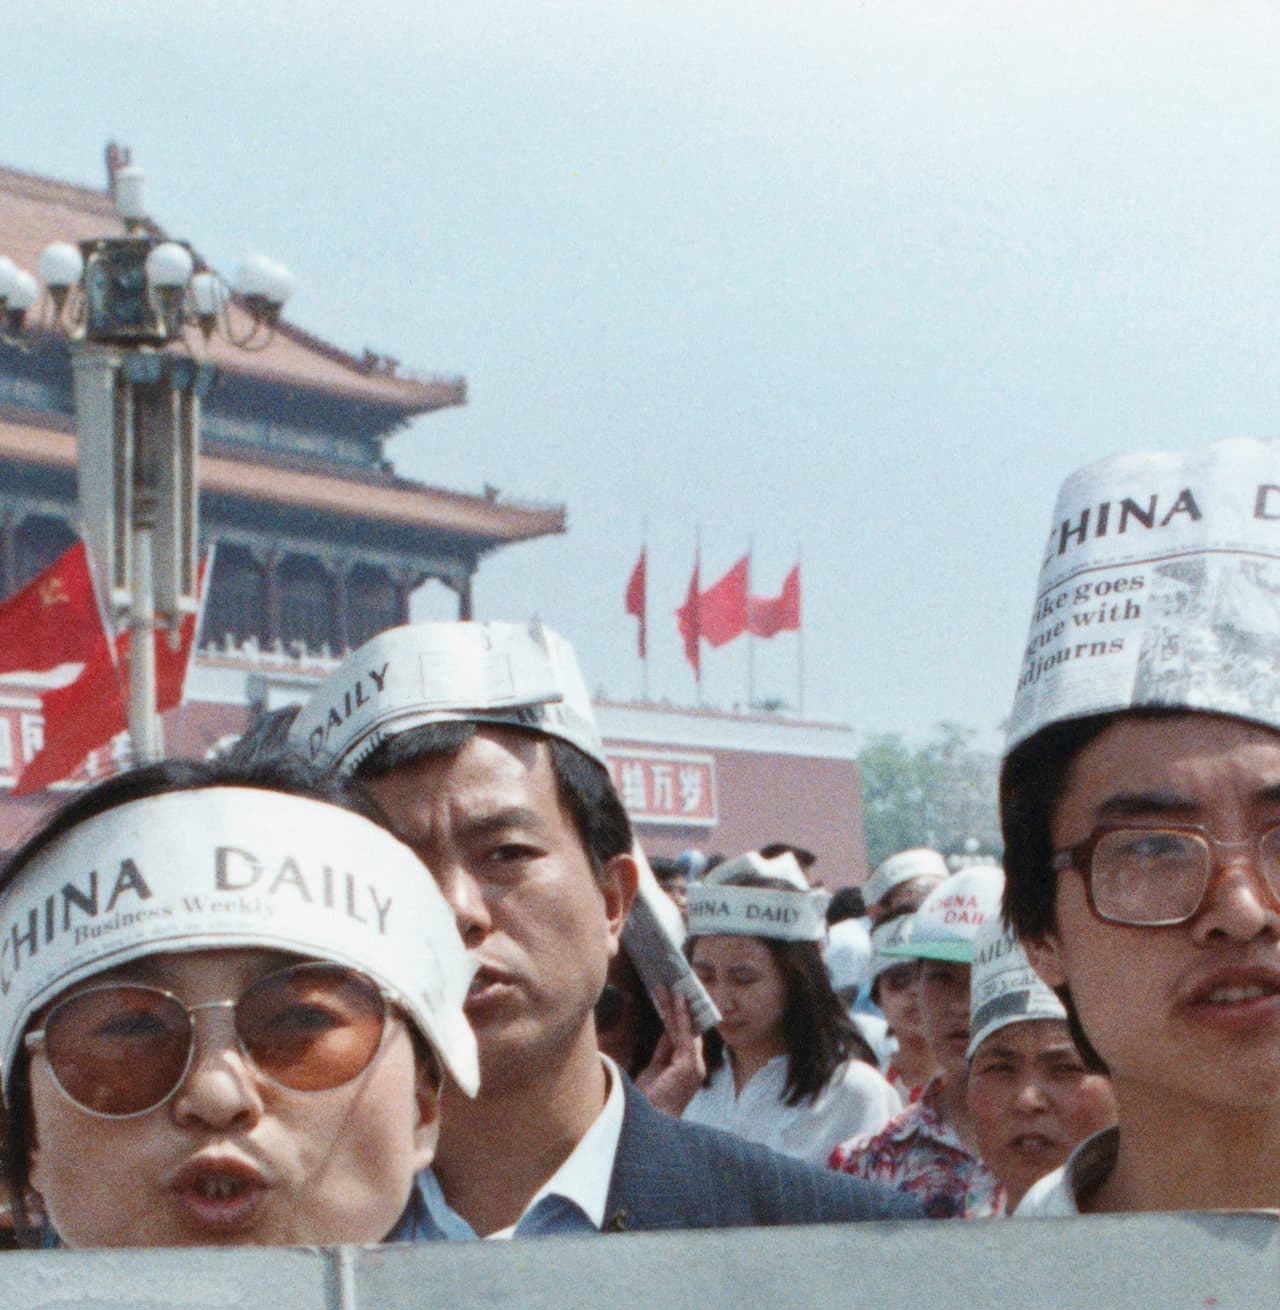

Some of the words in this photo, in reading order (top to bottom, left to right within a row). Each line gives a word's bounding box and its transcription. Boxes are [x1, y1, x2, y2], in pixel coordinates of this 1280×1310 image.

[1042, 488, 1202, 568] HINA
[1072, 598, 1141, 628] with
[1073, 575, 1145, 606] goes
[309, 662, 389, 757] DAILY
[0, 856, 153, 996] CHINA
[214, 845, 393, 935] DAILY
[73, 905, 173, 946] Business
[181, 894, 277, 919] Weekly
